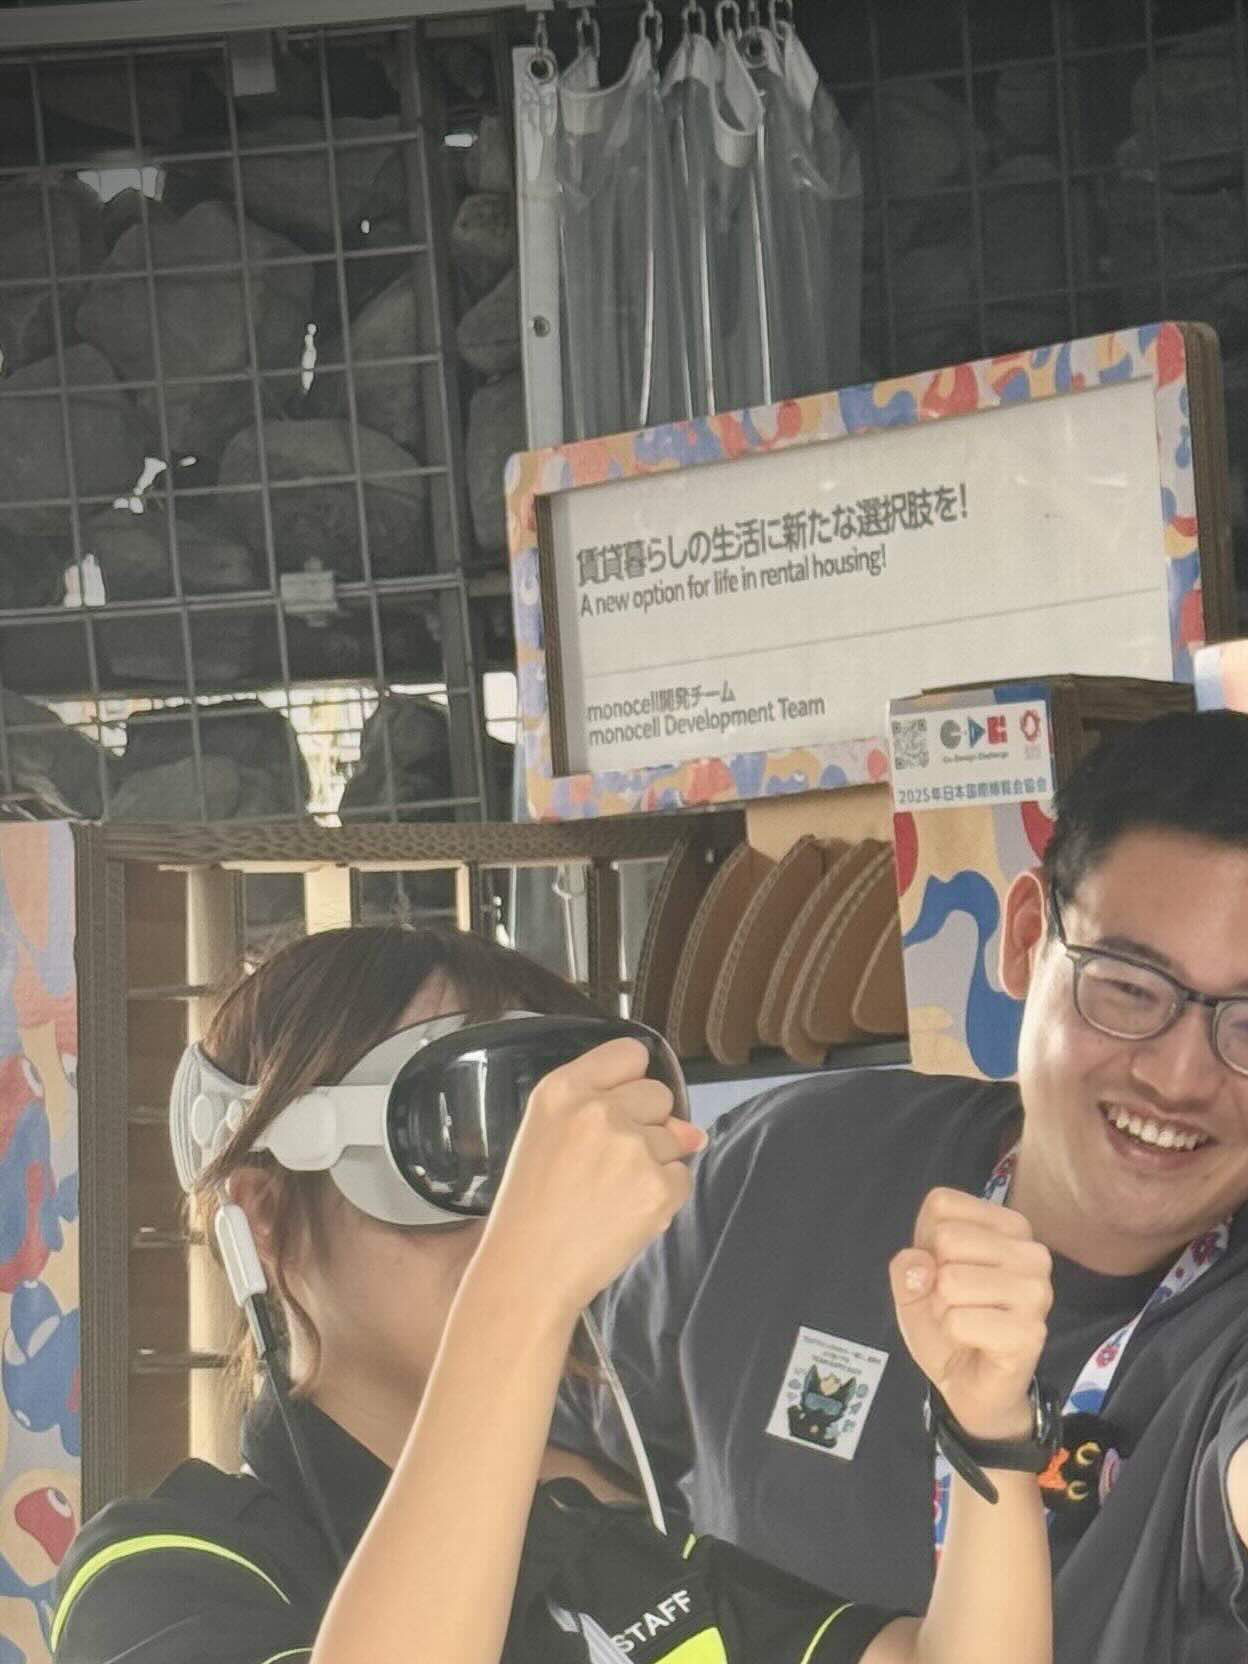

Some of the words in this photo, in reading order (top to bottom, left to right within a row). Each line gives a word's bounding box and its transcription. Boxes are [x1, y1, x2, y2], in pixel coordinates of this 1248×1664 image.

[580, 593, 594, 619] A
[595, 588, 630, 615] new
[632, 578, 686, 614] option
[687, 573, 713, 601] for
[713, 565, 739, 597] life
[741, 564, 758, 592] in
[760, 552, 811, 587] rental
[813, 543, 888, 580] housing!
[588, 679, 737, 722] monocell開発チーム
[589, 715, 662, 747] monocell
[664, 702, 777, 736] Development
[777, 696, 826, 720] Team
[608, 1588, 692, 1655] STAFF
